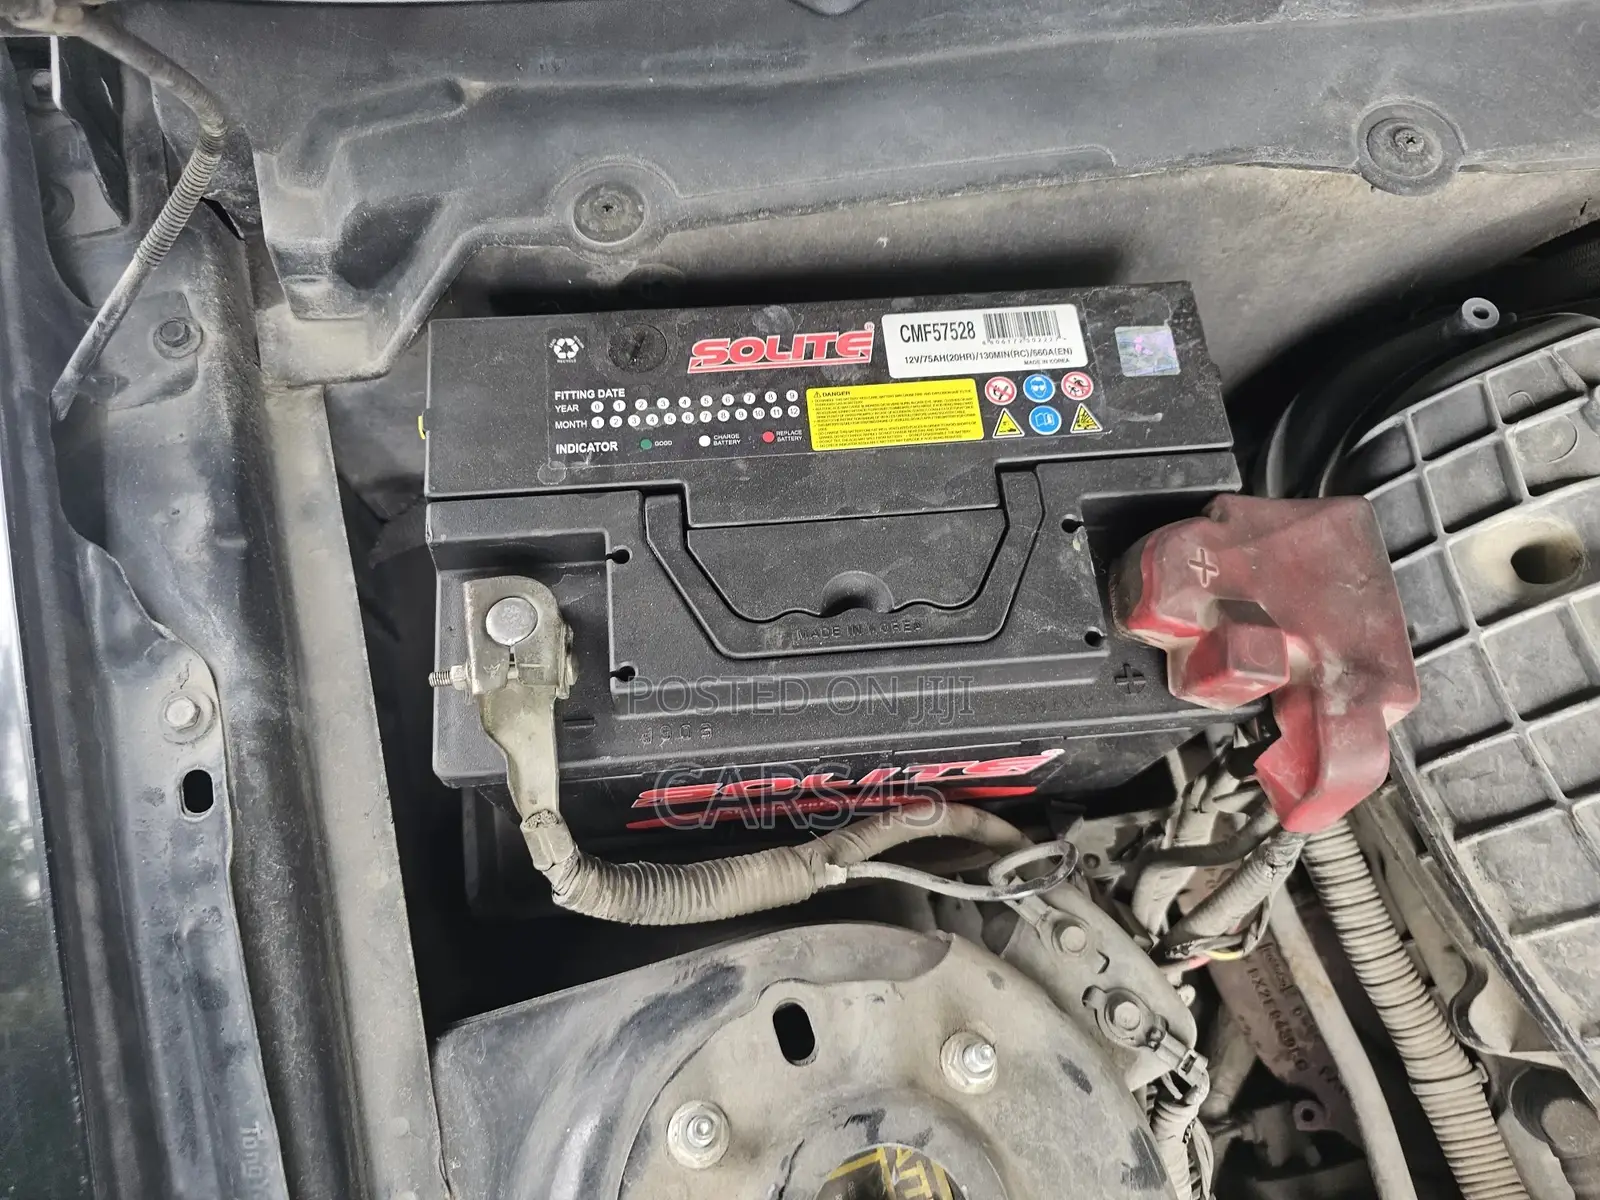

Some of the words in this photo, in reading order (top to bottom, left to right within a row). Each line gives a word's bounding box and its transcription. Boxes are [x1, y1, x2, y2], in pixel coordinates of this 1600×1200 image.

[900, 321, 976, 343] CMF57528
[687, 330, 874, 373] SOLITE
[554, 389, 596, 400] FITTING
[597, 388, 625, 398] DATE
[555, 404, 579, 413] YEAR
[554, 420, 587, 429] MONTH
[556, 441, 618, 454] INDICATOR
[796, 626, 841, 641] MADE
